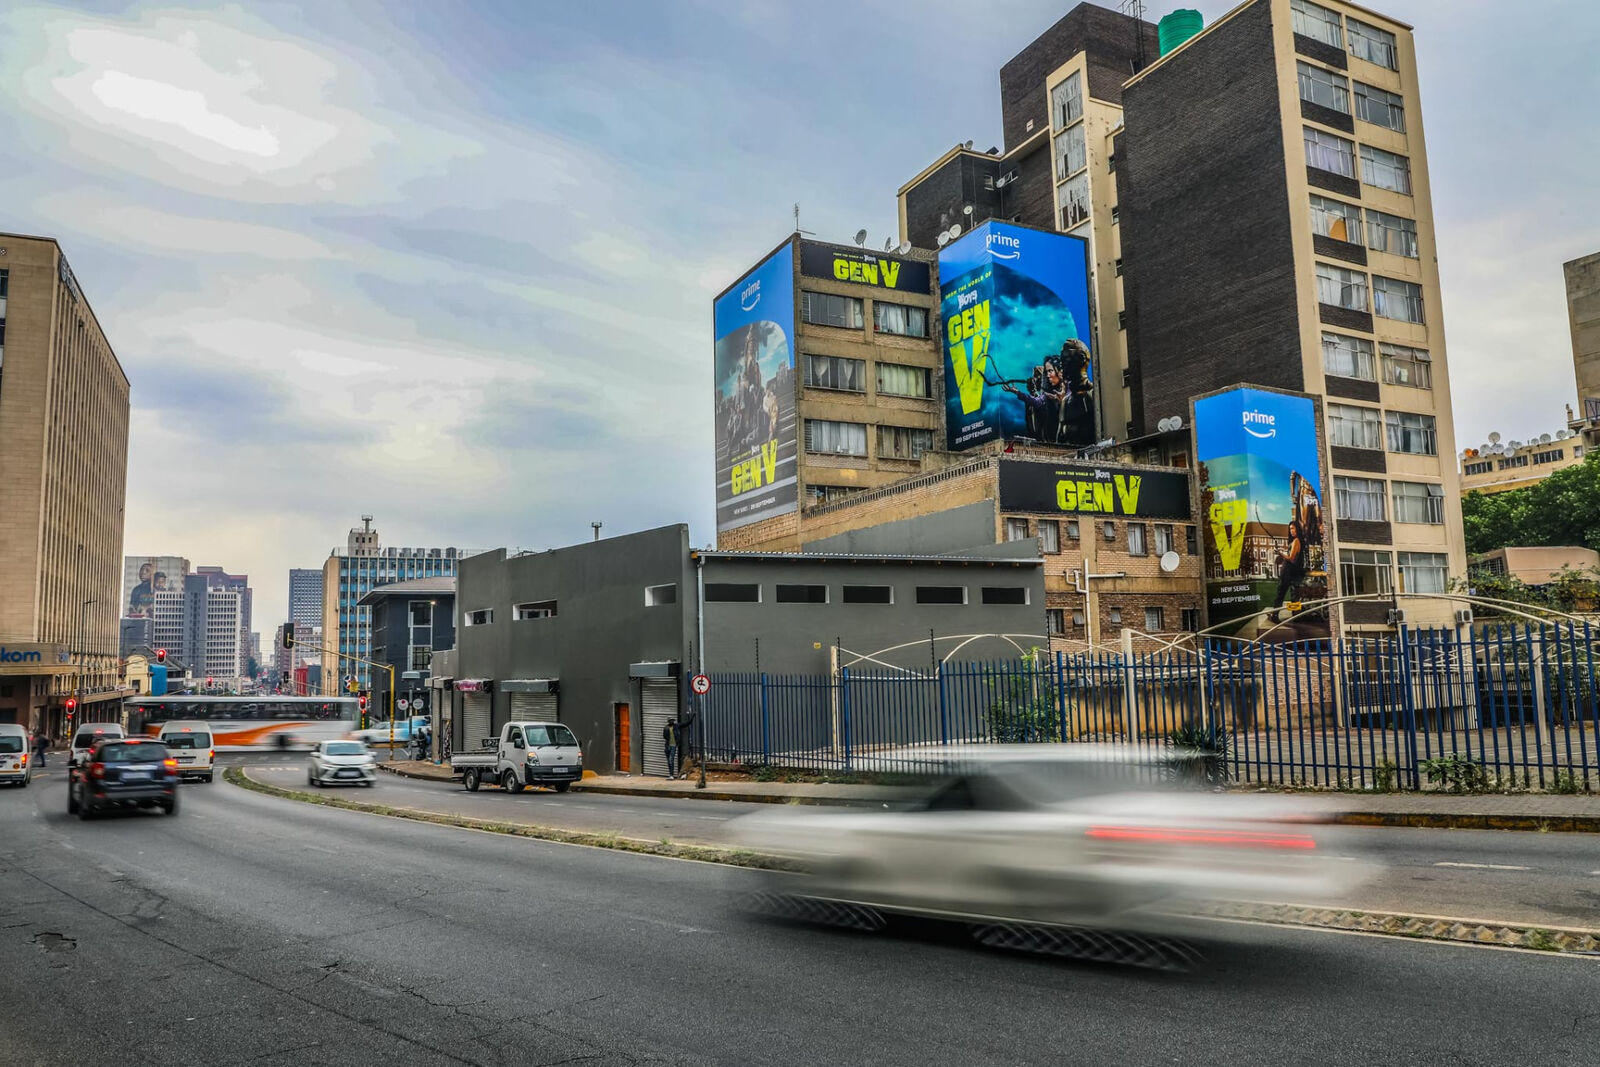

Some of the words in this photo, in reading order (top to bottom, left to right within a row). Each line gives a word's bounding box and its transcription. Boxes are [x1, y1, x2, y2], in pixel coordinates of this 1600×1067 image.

[986, 232, 1020, 248] prime
[833, 259, 878, 285] GEN
[878, 259, 900, 288] V
[741, 280, 760, 304] prime
[947, 299, 990, 343] GEN
[949, 330, 991, 415] V
[1242, 409, 1275, 425] prime
[963, 427, 992, 441] SEPTEMBER
[731, 456, 761, 496] GEN
[761, 438, 778, 484] V
[1056, 480, 1113, 513] GEN
[1113, 474, 1142, 515] V
[1209, 499, 1248, 522] GEN
[1210, 520, 1248, 571] V
[1221, 594, 1261, 604] SEPTEMBER
[1233, 584, 1250, 592] SERIES
